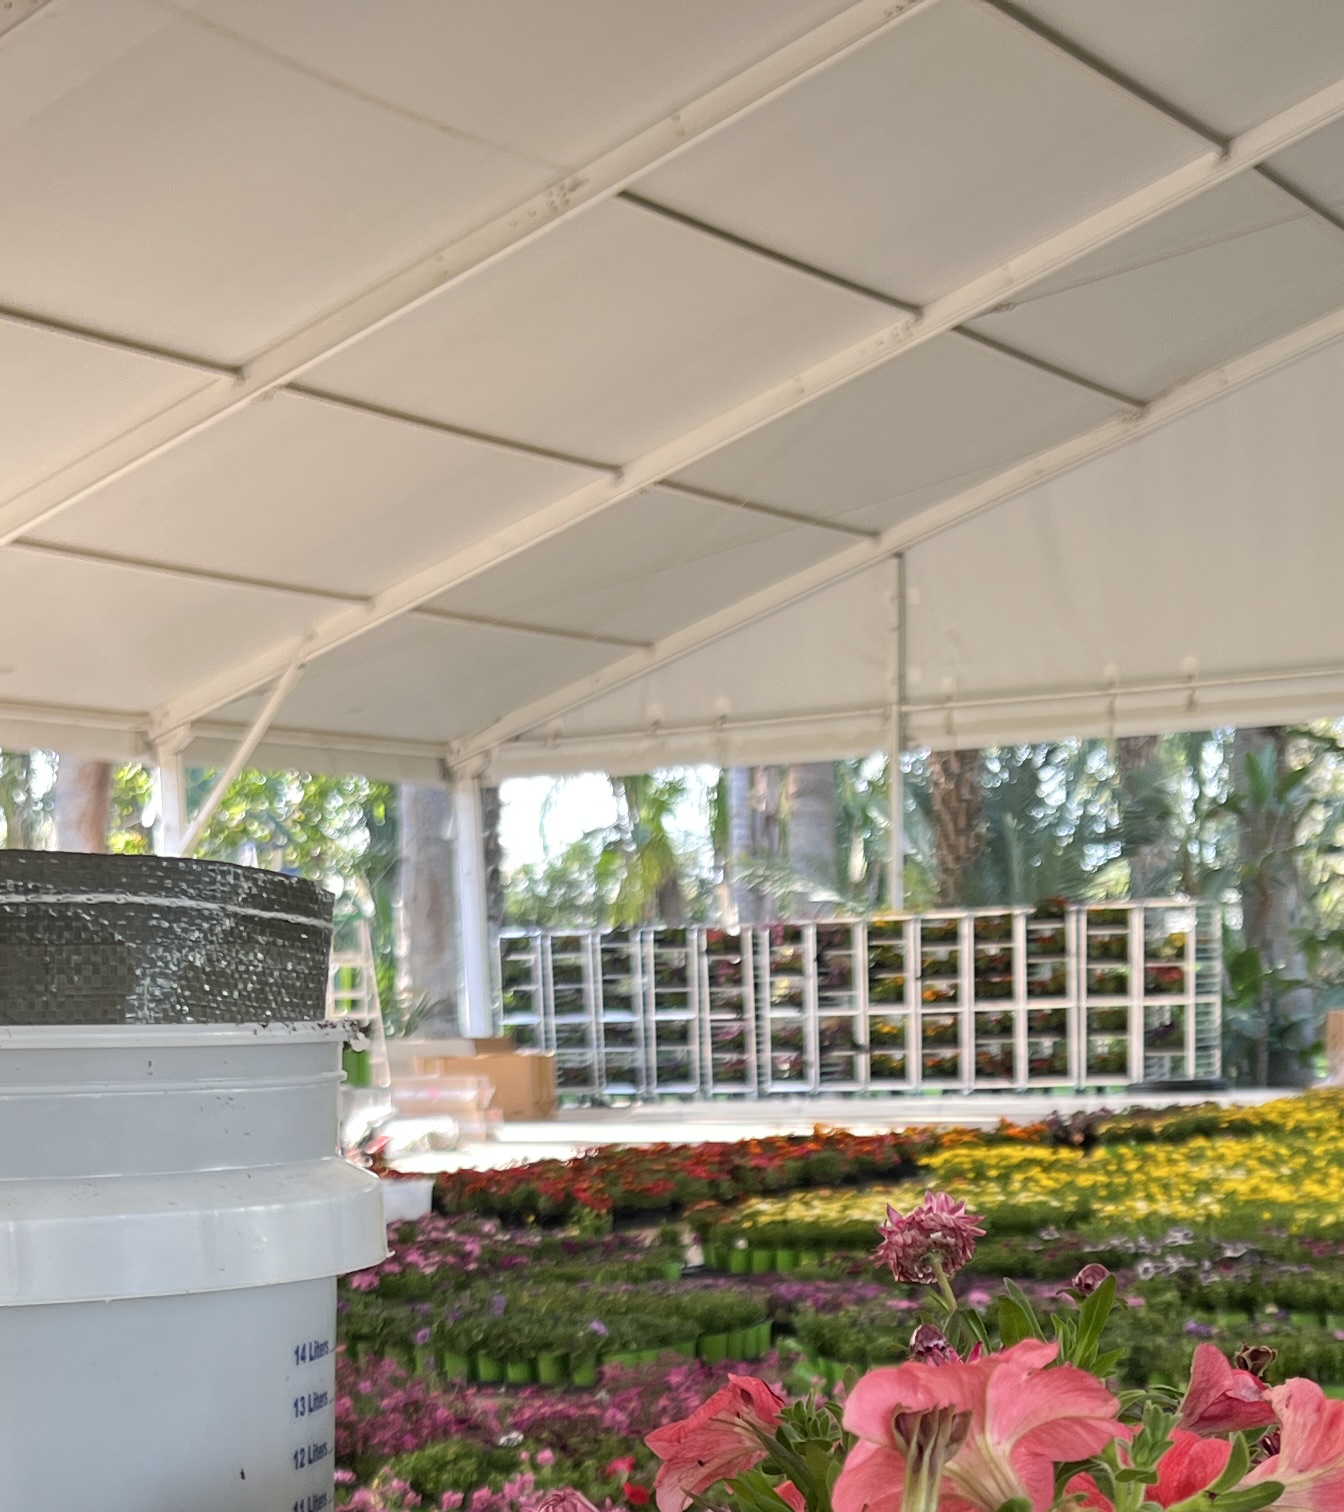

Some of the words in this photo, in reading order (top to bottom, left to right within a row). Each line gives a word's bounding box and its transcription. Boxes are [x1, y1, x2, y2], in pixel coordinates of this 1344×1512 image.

[295, 1343, 306, 1366] 14
[294, 1396, 306, 1418] 13
[293, 1447, 306, 1470] 12
